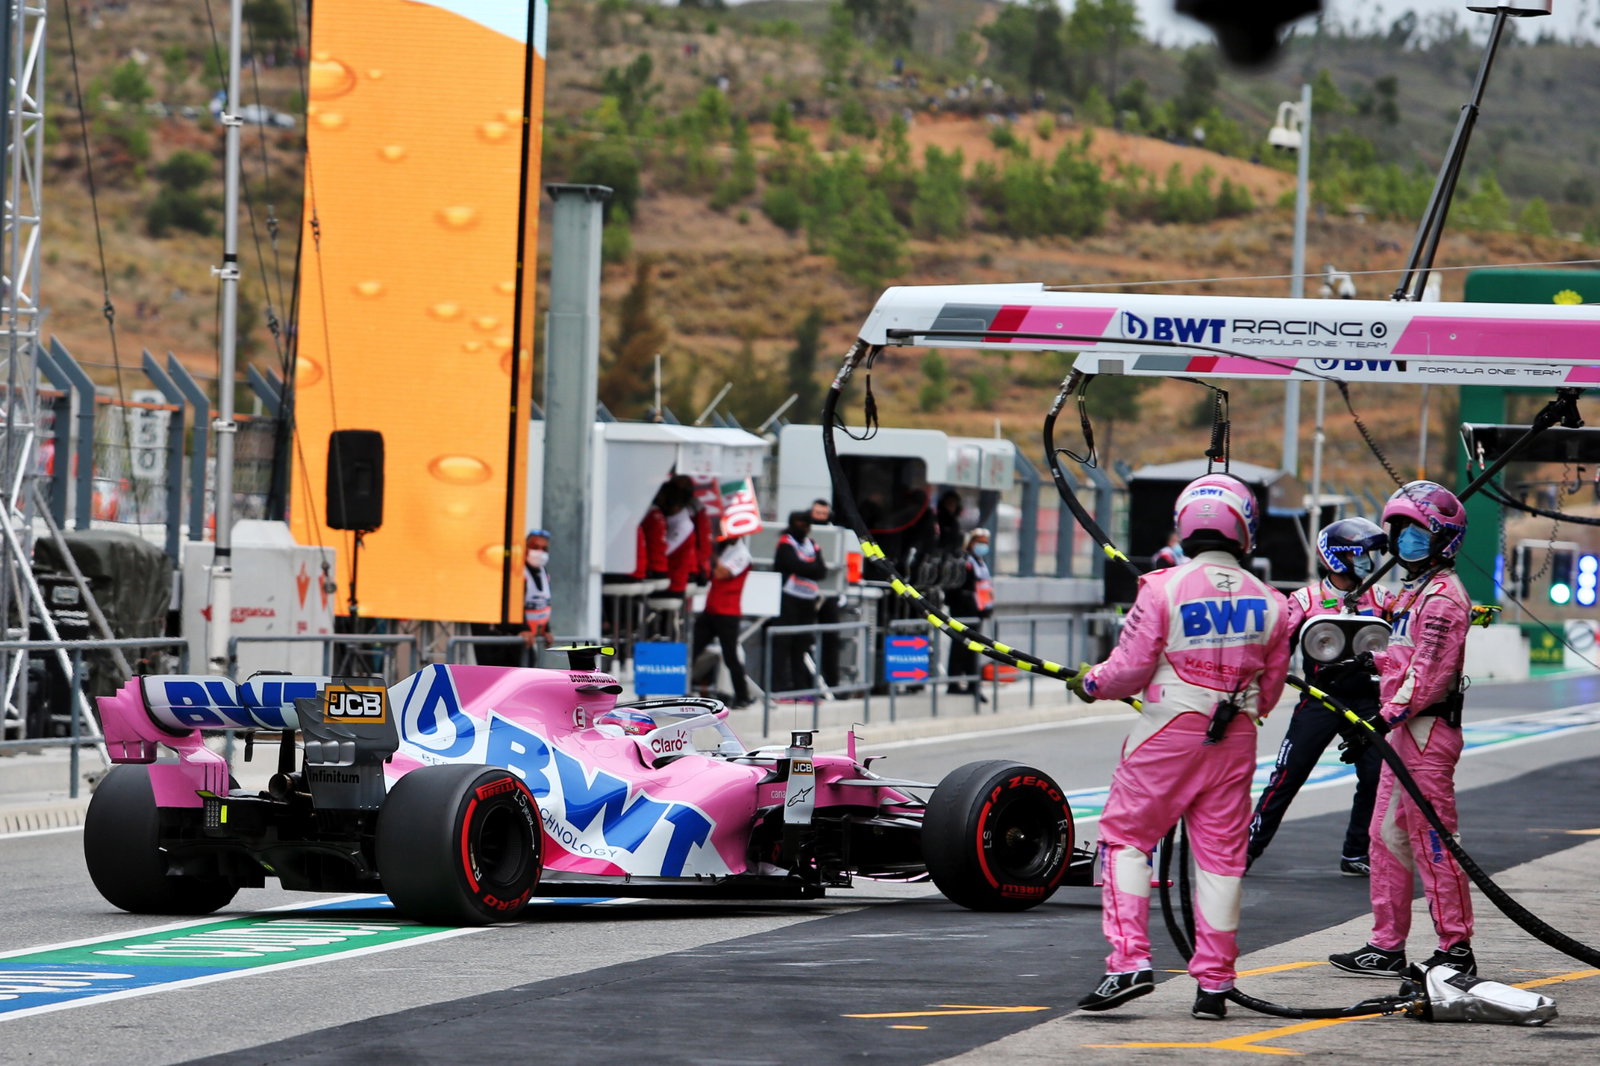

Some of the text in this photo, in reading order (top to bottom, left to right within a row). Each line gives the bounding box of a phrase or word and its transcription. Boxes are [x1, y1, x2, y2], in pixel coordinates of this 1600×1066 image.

[1153, 317, 1363, 343] BWT RACING
[1232, 337, 1388, 348] FORMULA ONE TEAM
[1418, 366, 1484, 375] FORMULA
[1180, 598, 1269, 637] BWT
[887, 654, 930, 664] WILLIAMS
[636, 664, 686, 675] WILLIAMS
[569, 674, 617, 684] BOMBARDIER
[164, 681, 317, 728] BWT
[329, 693, 381, 716] JCB
[651, 736, 684, 754] Claro
[794, 763, 813, 773] JCB
[475, 777, 516, 801] PIRELLI
[485, 716, 713, 878] BWT
[770, 790, 786, 799] cana
[990, 775, 1062, 803] P ZERO
[540, 808, 617, 858] CHNOLOGY
[1001, 883, 1046, 898] PIRELLI
